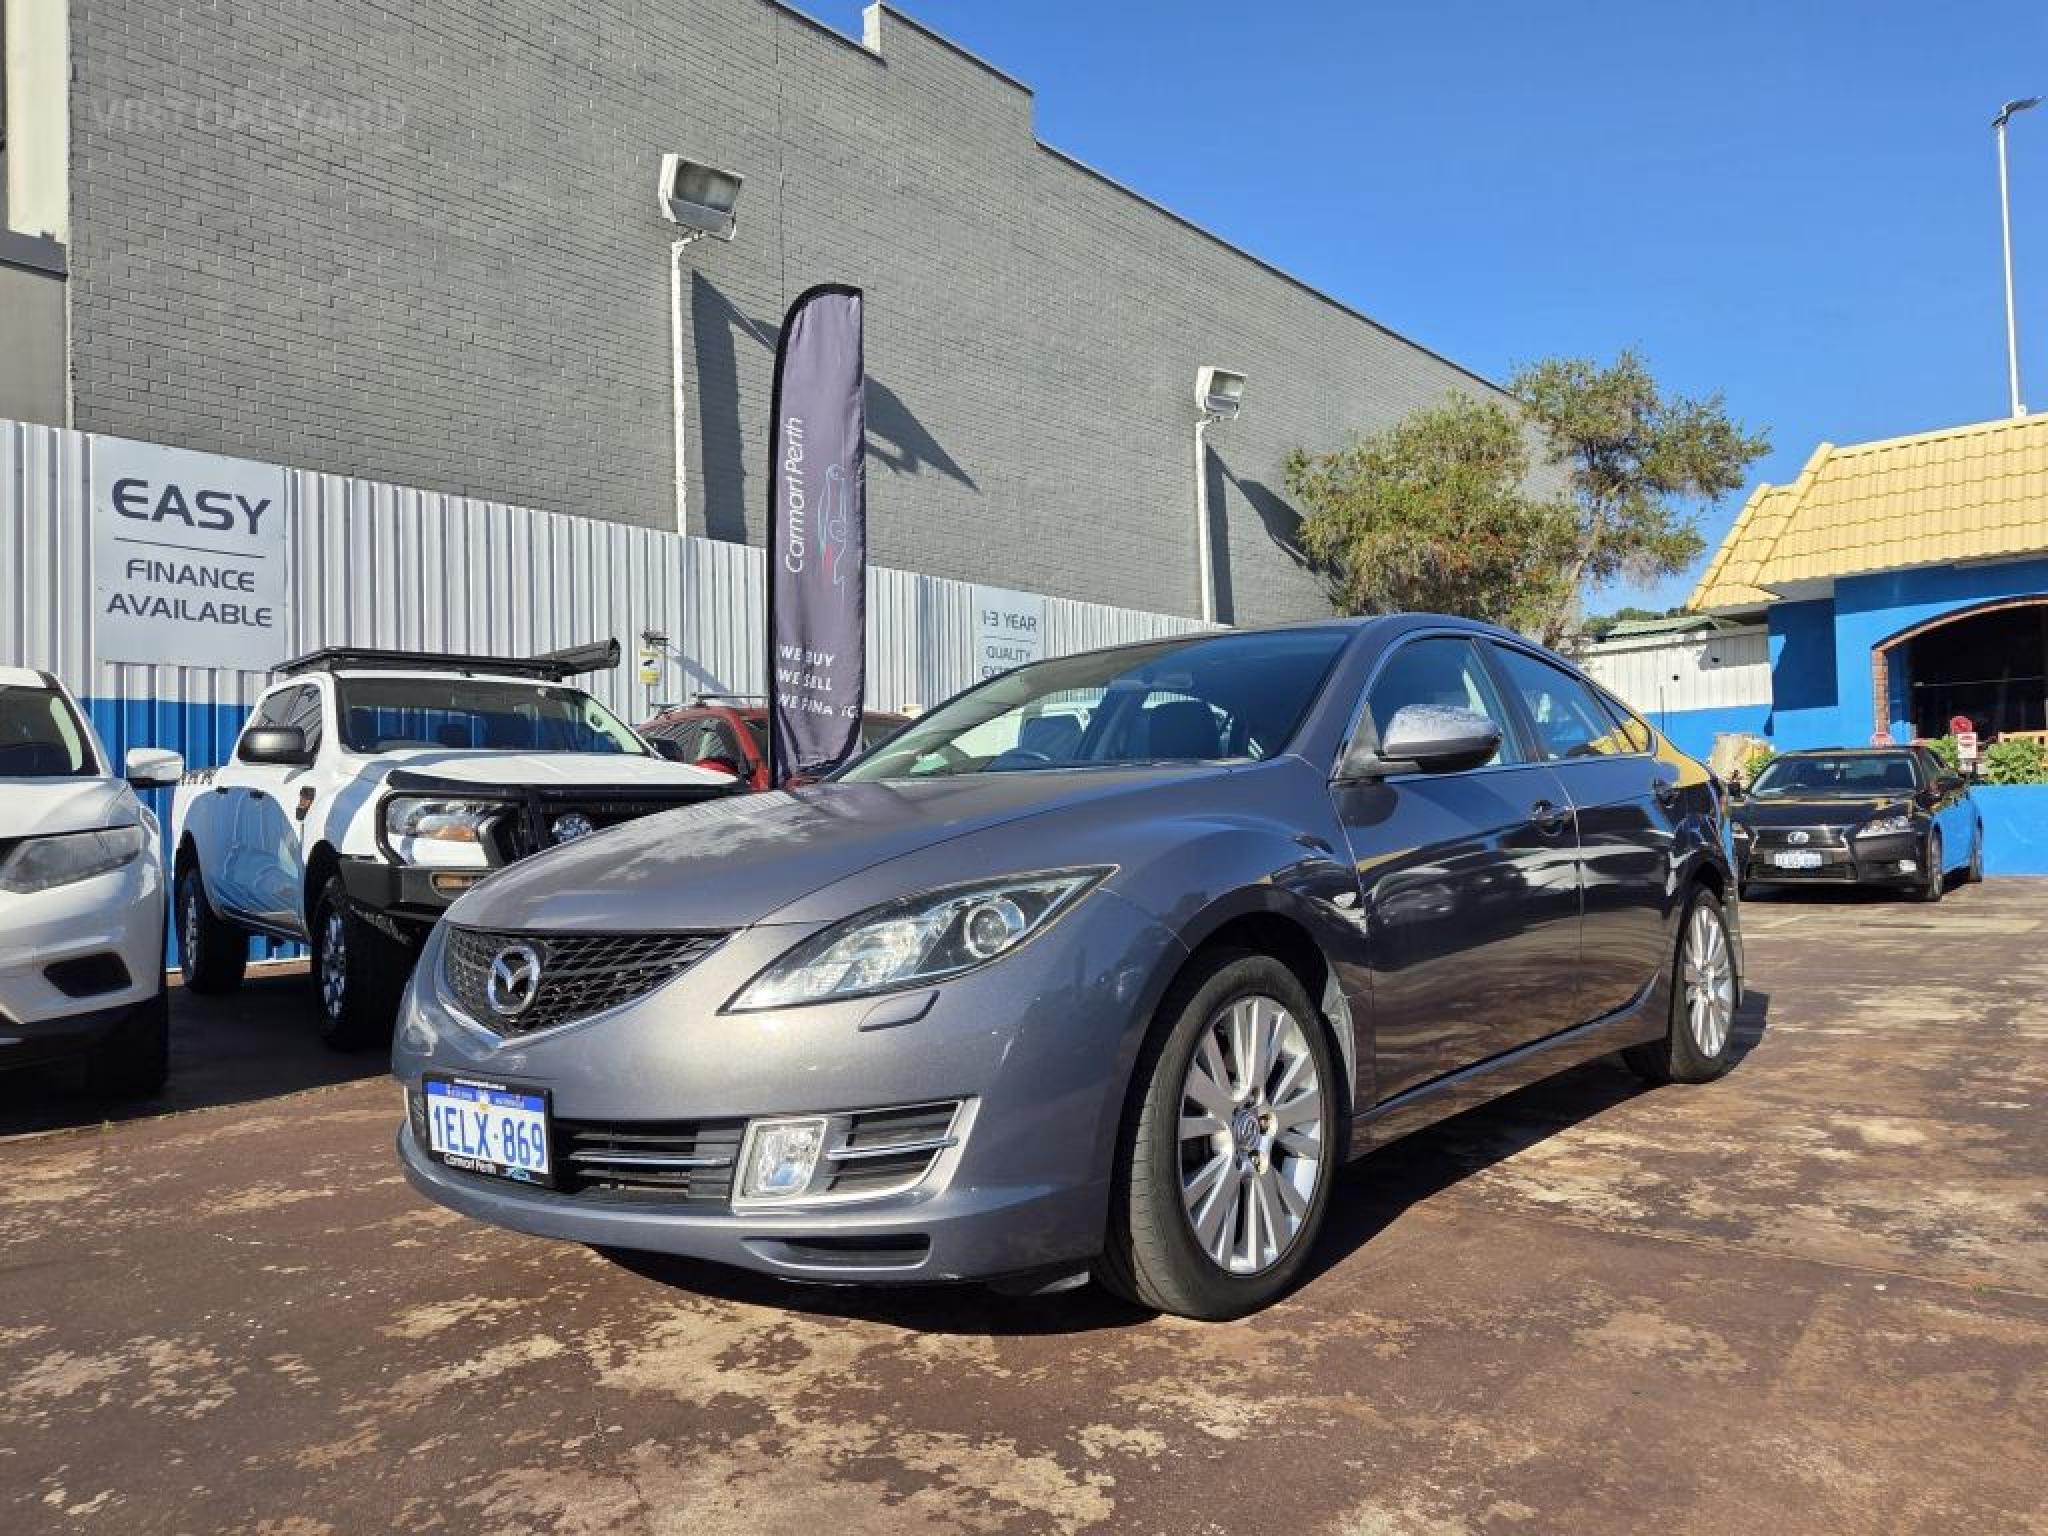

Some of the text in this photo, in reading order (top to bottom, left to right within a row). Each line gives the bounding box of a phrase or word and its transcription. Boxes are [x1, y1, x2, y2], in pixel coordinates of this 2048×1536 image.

[112, 477, 272, 535] EASY
[784, 416, 805, 573] Carmart Perth
[126, 559, 255, 593] FINANCE
[106, 593, 273, 628] AVAILABLE
[1003, 611, 1037, 632] YEAR
[780, 644, 834, 667] WE BUY
[779, 668, 833, 691] WE SELL
